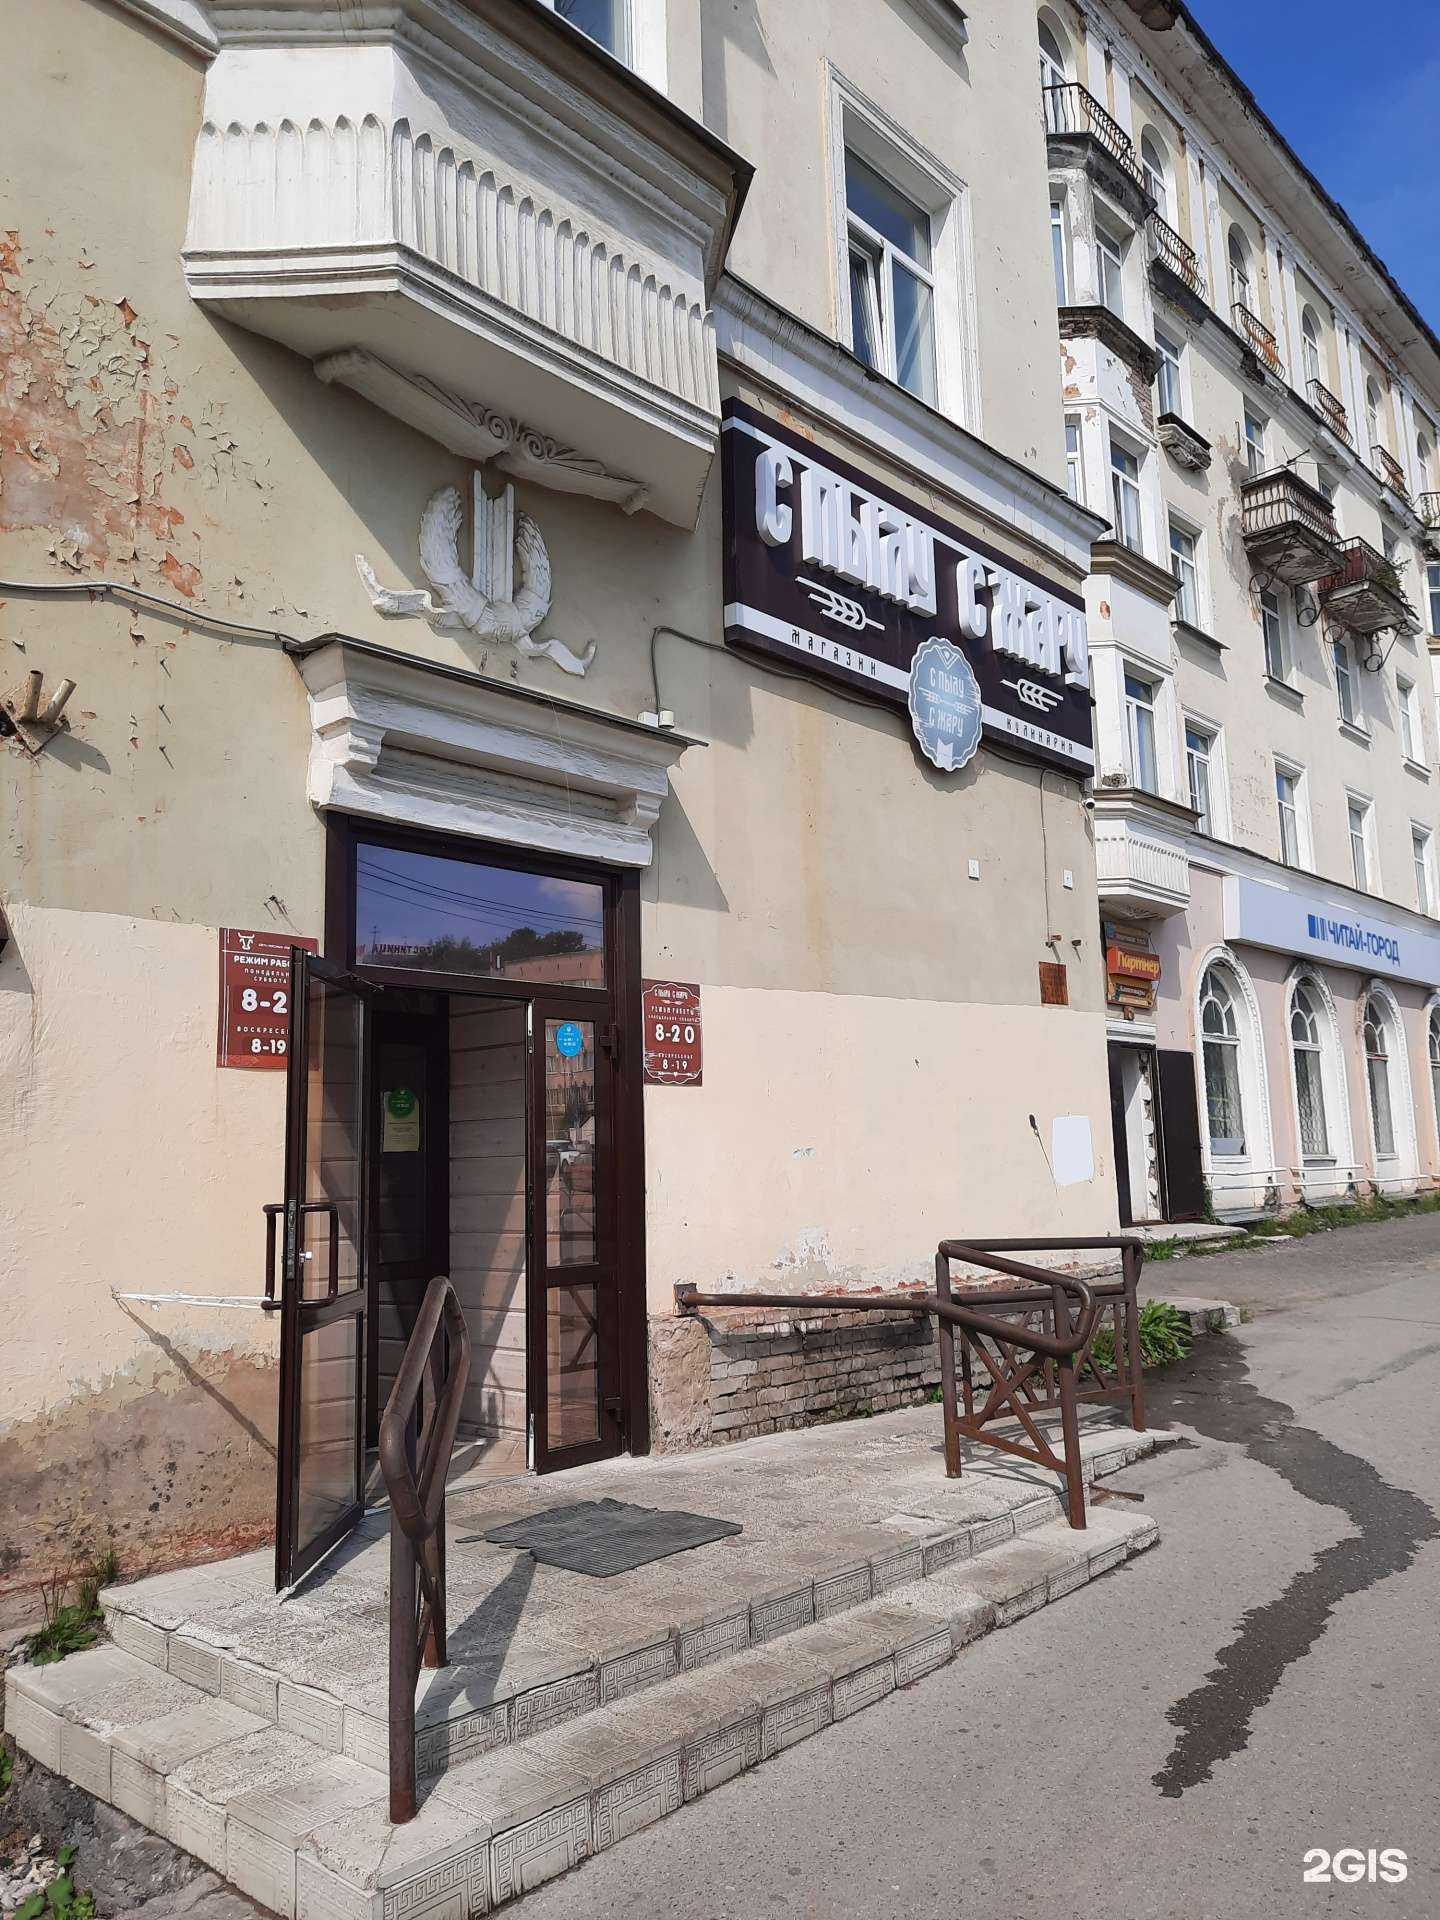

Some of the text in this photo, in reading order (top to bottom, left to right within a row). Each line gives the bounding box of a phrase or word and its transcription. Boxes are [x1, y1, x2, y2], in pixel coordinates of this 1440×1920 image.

[755, 446, 793, 547] С
[956, 557, 987, 640] С
[791, 628, 877, 677] МАГАЗИН
[937, 709, 964, 738] ЖАРУ
[1006, 717, 1073, 755] КУЛИНАРИЯ
[1328, 920, 1400, 967] ЧИТАЙ-ГОРОД
[234, 955, 268, 966] РЕЖИМ
[244, 968, 290, 977] ПОНЕДЕЛЬН
[253, 976, 287, 984] СУББОТА
[241, 988, 288, 1014] 8-2
[655, 1023, 695, 1044] 8-20
[251, 1038, 287, 1054] 8-19
[662, 1058, 688, 1070] 8-19
